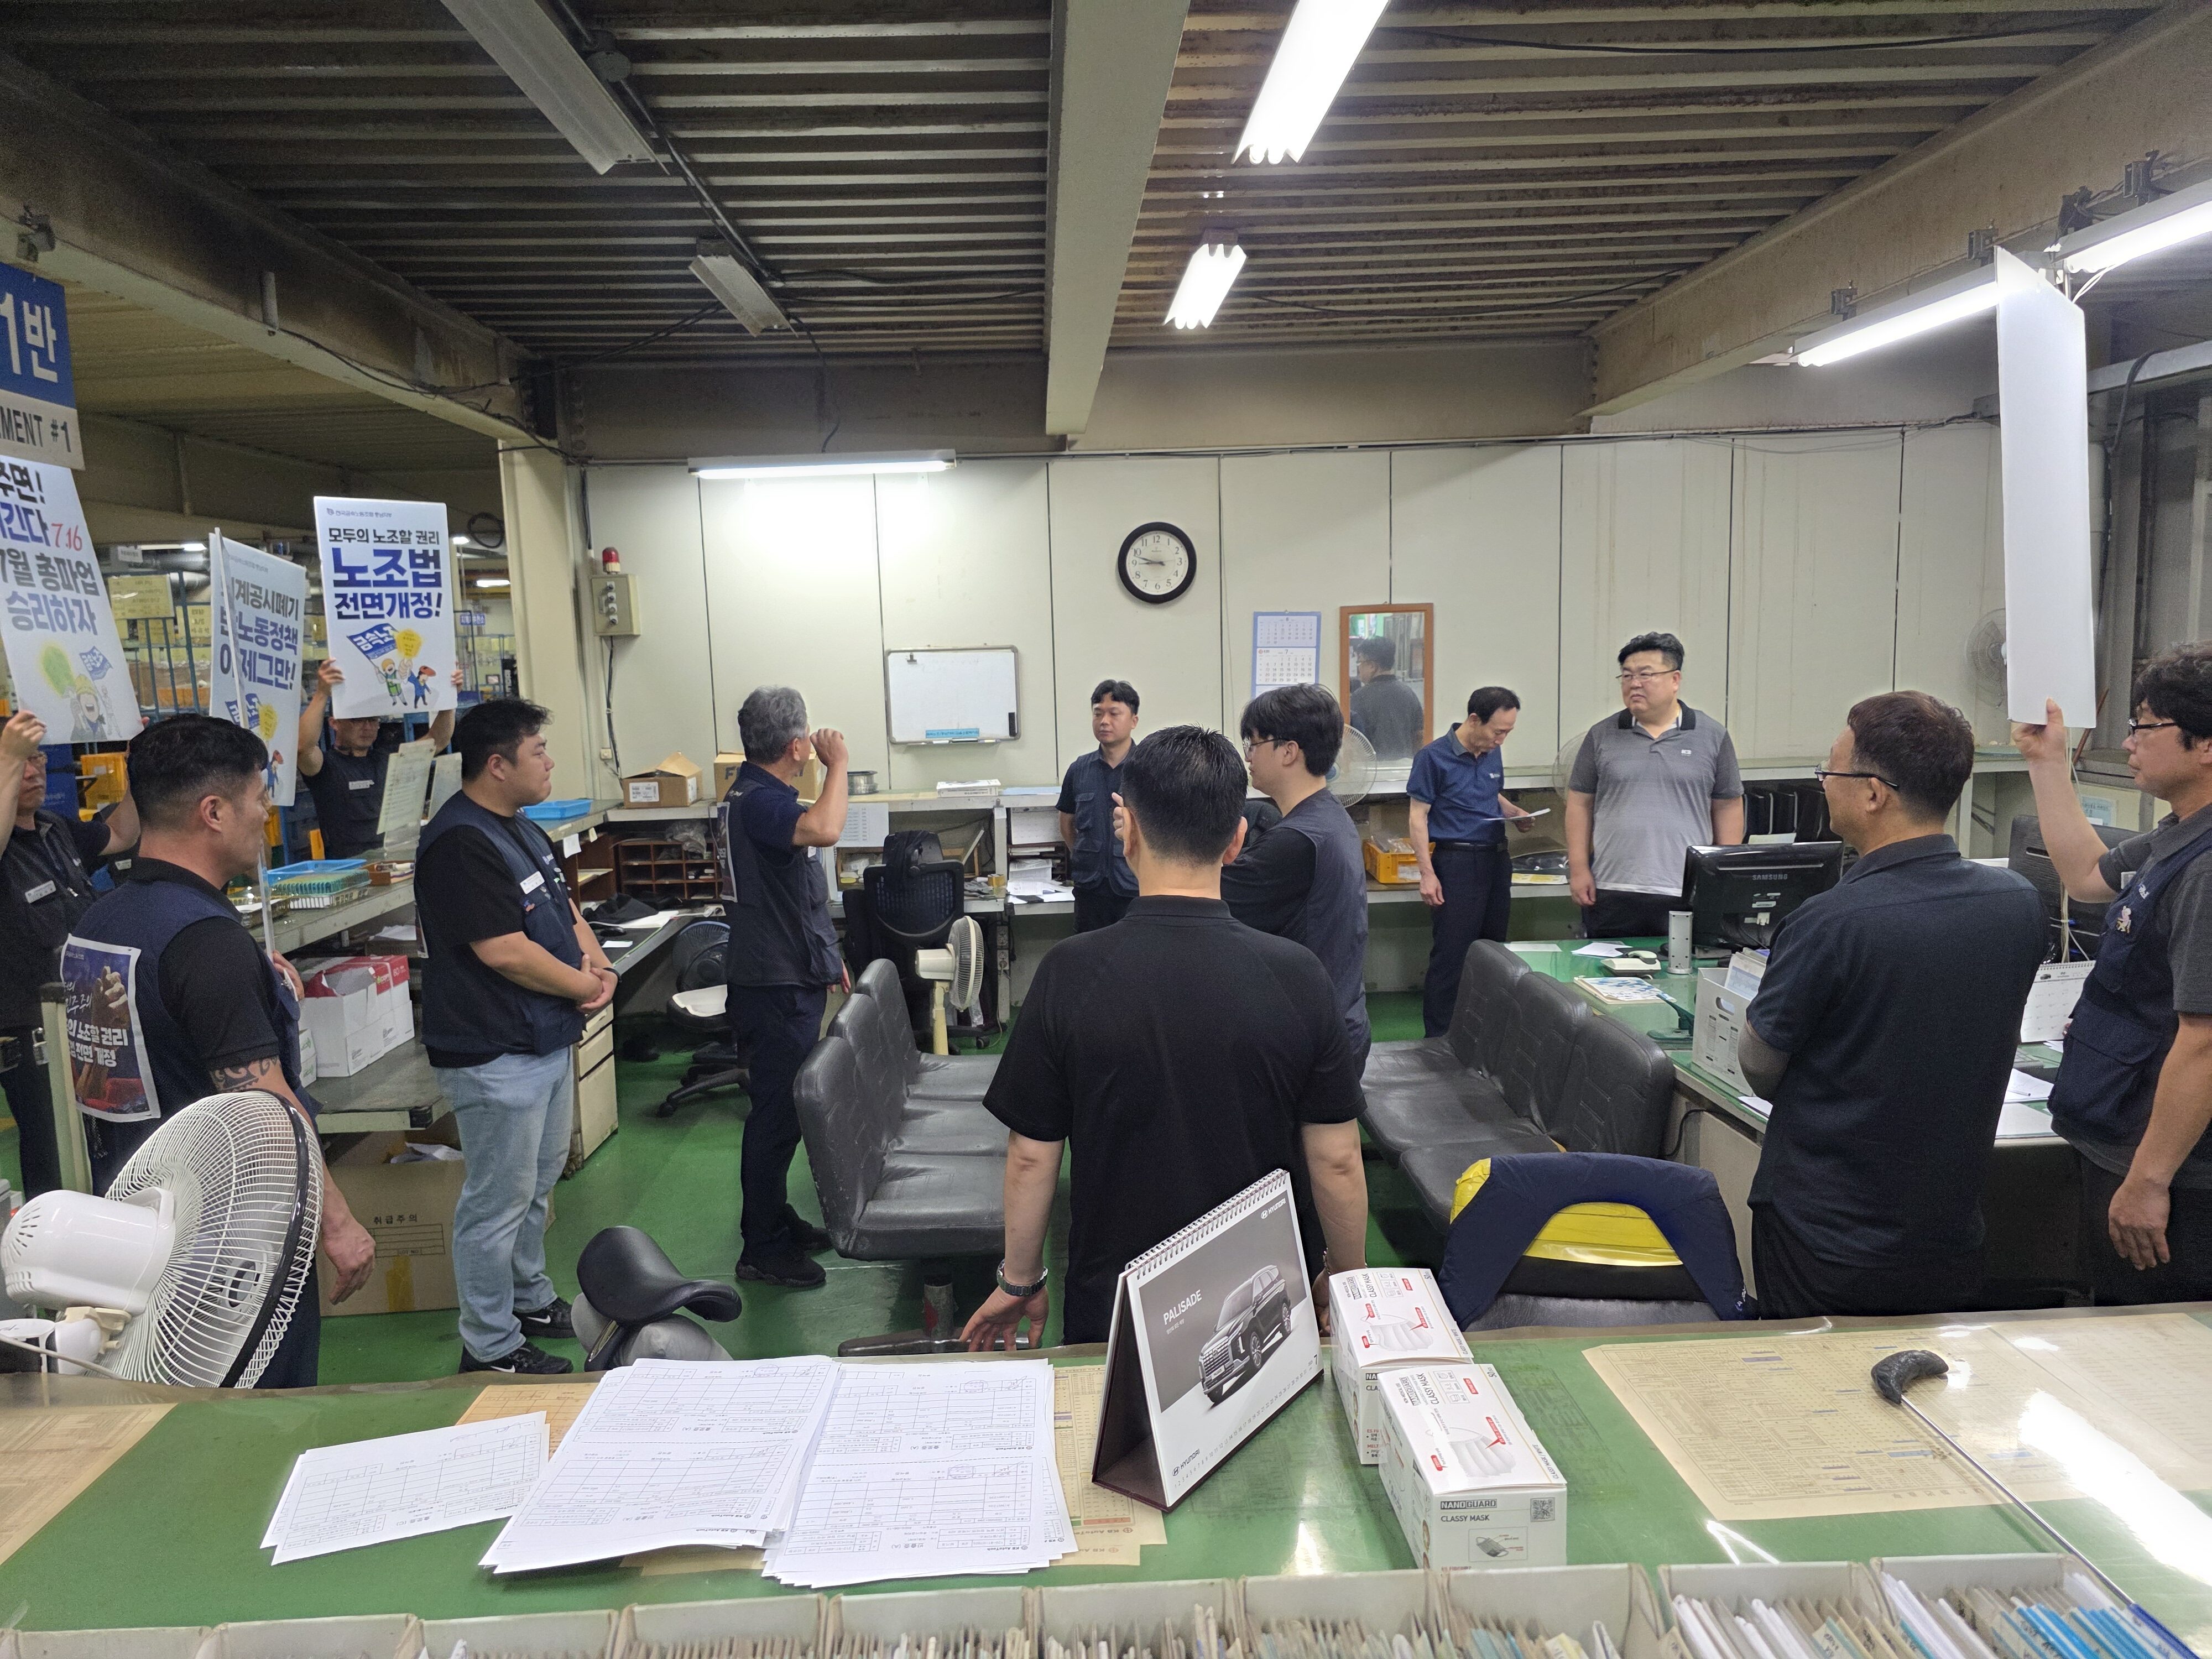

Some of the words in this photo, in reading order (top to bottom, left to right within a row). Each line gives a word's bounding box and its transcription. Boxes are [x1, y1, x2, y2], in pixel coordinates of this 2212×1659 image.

[0, 405, 43, 447] MENT
[50, 419, 71, 452] #1
[0, 501, 50, 547] 긴다
[328, 528, 369, 543] 모두의
[373, 529, 413, 544] 노조할
[416, 530, 440, 545] 권리
[34, 552, 100, 596] 총파업
[332, 547, 442, 588] 노조법
[5, 590, 98, 636] 승리하자
[335, 592, 443, 619] 전면개정!
[101, 1027, 128, 1046] 권리
[1268, 1198, 1286, 1214] HYUNDAI
[374, 1214, 418, 1225] 취급주의
[1361, 1273, 1372, 1284] MASK
[1365, 1284, 1377, 1297] CLASSY
[1163, 1289, 1202, 1325] PALISADE
[1313, 1354, 1317, 1365] 7
[1416, 1373, 1430, 1386] MASK
[1423, 1387, 1439, 1405] CLASSY
[1180, 1448, 1200, 1469] HYUNDAI
[1546, 1466, 1559, 1479] CLASSY
[1441, 1499, 1498, 1510] NANOGUARD
